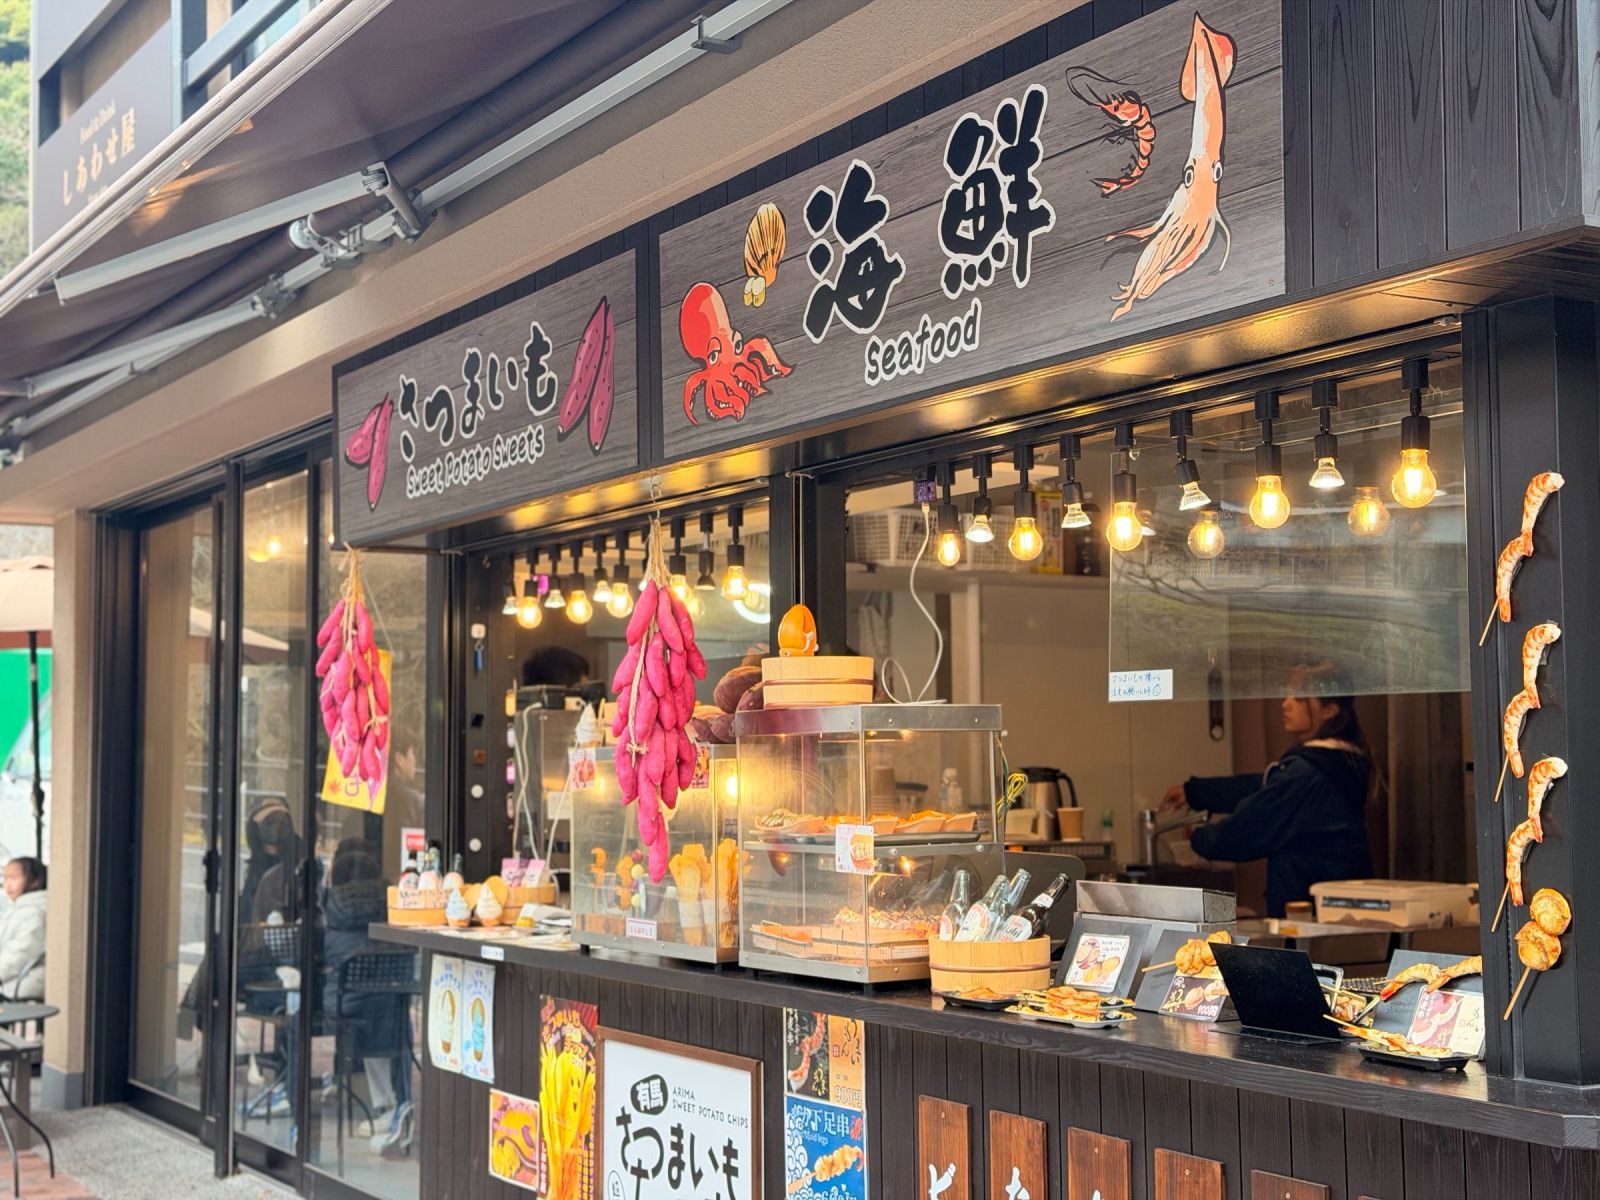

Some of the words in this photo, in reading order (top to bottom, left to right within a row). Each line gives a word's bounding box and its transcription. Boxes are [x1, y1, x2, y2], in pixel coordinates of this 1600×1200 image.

[63, 107, 135, 206] しあわせ屋
[803, 84, 1055, 343] 海鮮
[399, 321, 558, 463] さつまいも
[635, 1078, 664, 1111] 有馬
[672, 1087, 696, 1101] ARIMA
[672, 1098, 696, 1114] SWEET
[699, 1106, 725, 1122] POTATO
[727, 1114, 749, 1129] CHIPS
